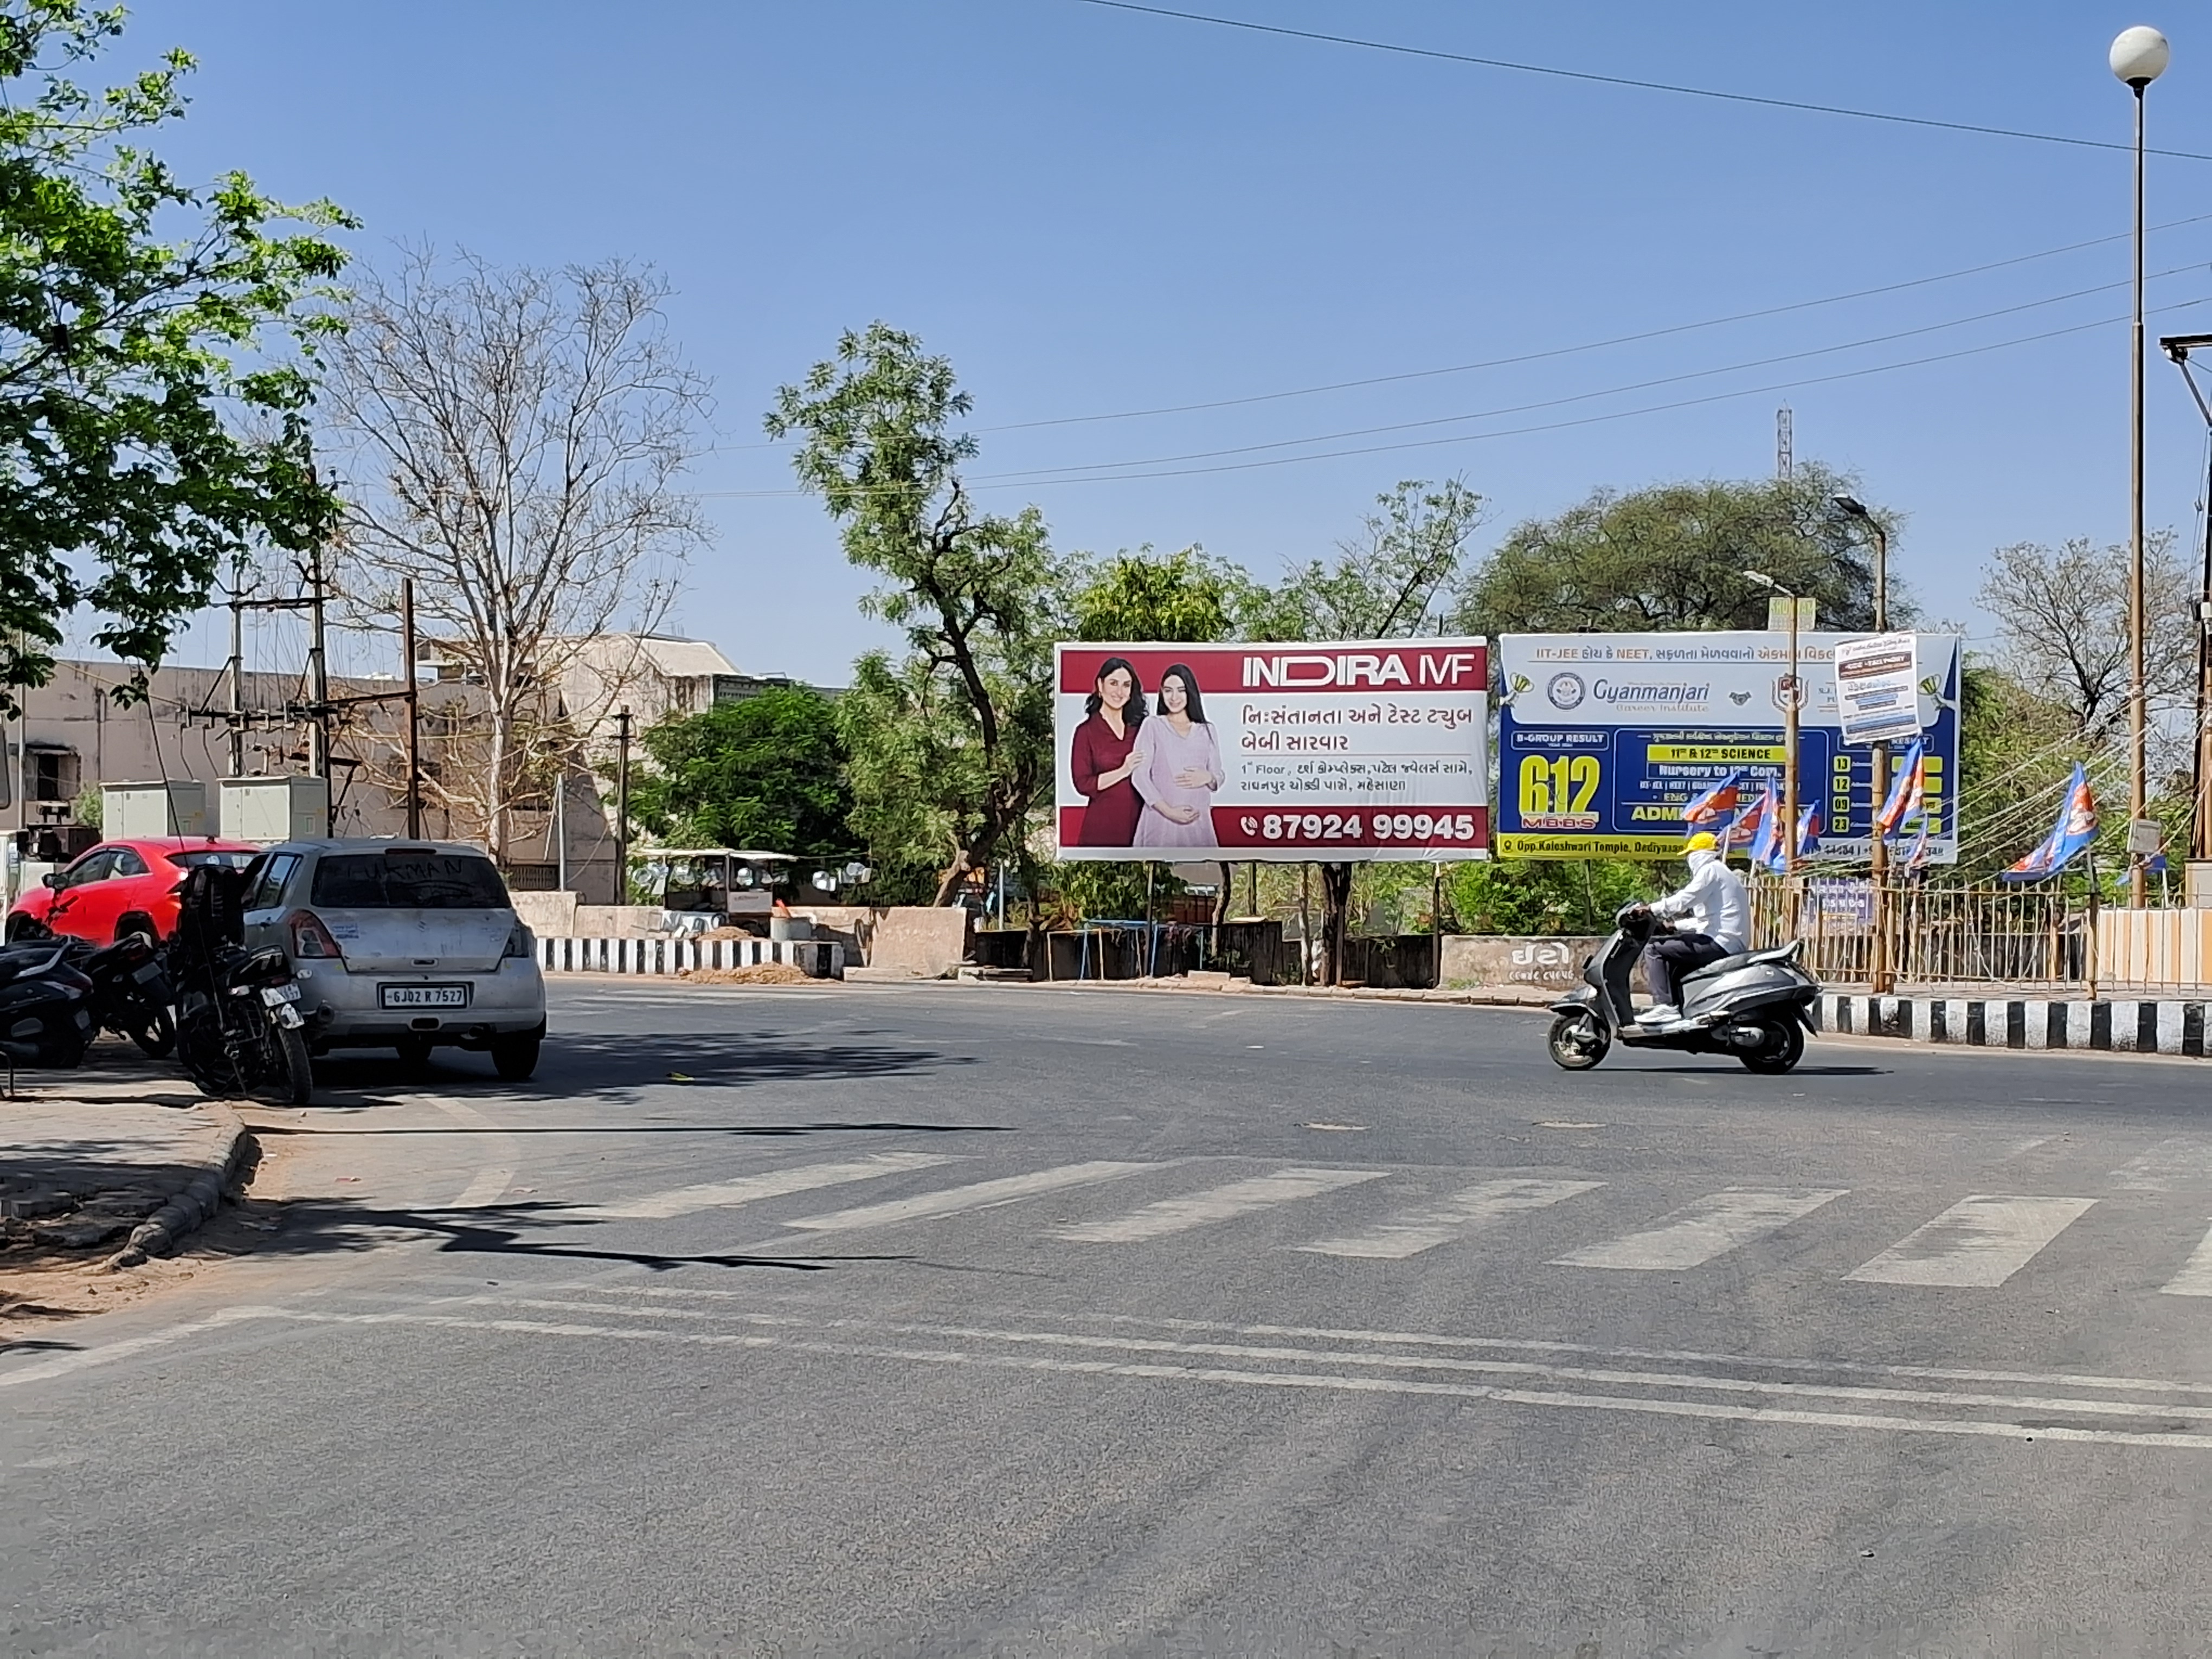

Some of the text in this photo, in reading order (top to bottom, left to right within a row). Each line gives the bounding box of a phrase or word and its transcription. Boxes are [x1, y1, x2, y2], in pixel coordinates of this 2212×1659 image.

[1536, 648, 1578, 659] IIT-JEE
[1617, 649, 1652, 660] NEET,
[1243, 654, 1475, 686] INDIRA IVF
[1593, 679, 1710, 704] Gyanmanjari
[1348, 704, 1381, 724] અને
[1387, 703, 1421, 724] ટેસ્ટ
[1242, 730, 1348, 750] બેબી સારવાર
[1566, 734, 1604, 743] RESULT
[1721, 749, 1771, 760] SCIENCE
[1836, 757, 1848, 770] 13
[1659, 764, 1712, 777] Nursery
[1714, 765, 1727, 776] to
[1519, 755, 1600, 815] 612
[1836, 777, 1848, 790] 12
[1263, 814, 1475, 840] 87924 99945
[1835, 818, 1847, 830] 23
[394, 990, 462, 1002] GJ02 R 7527
